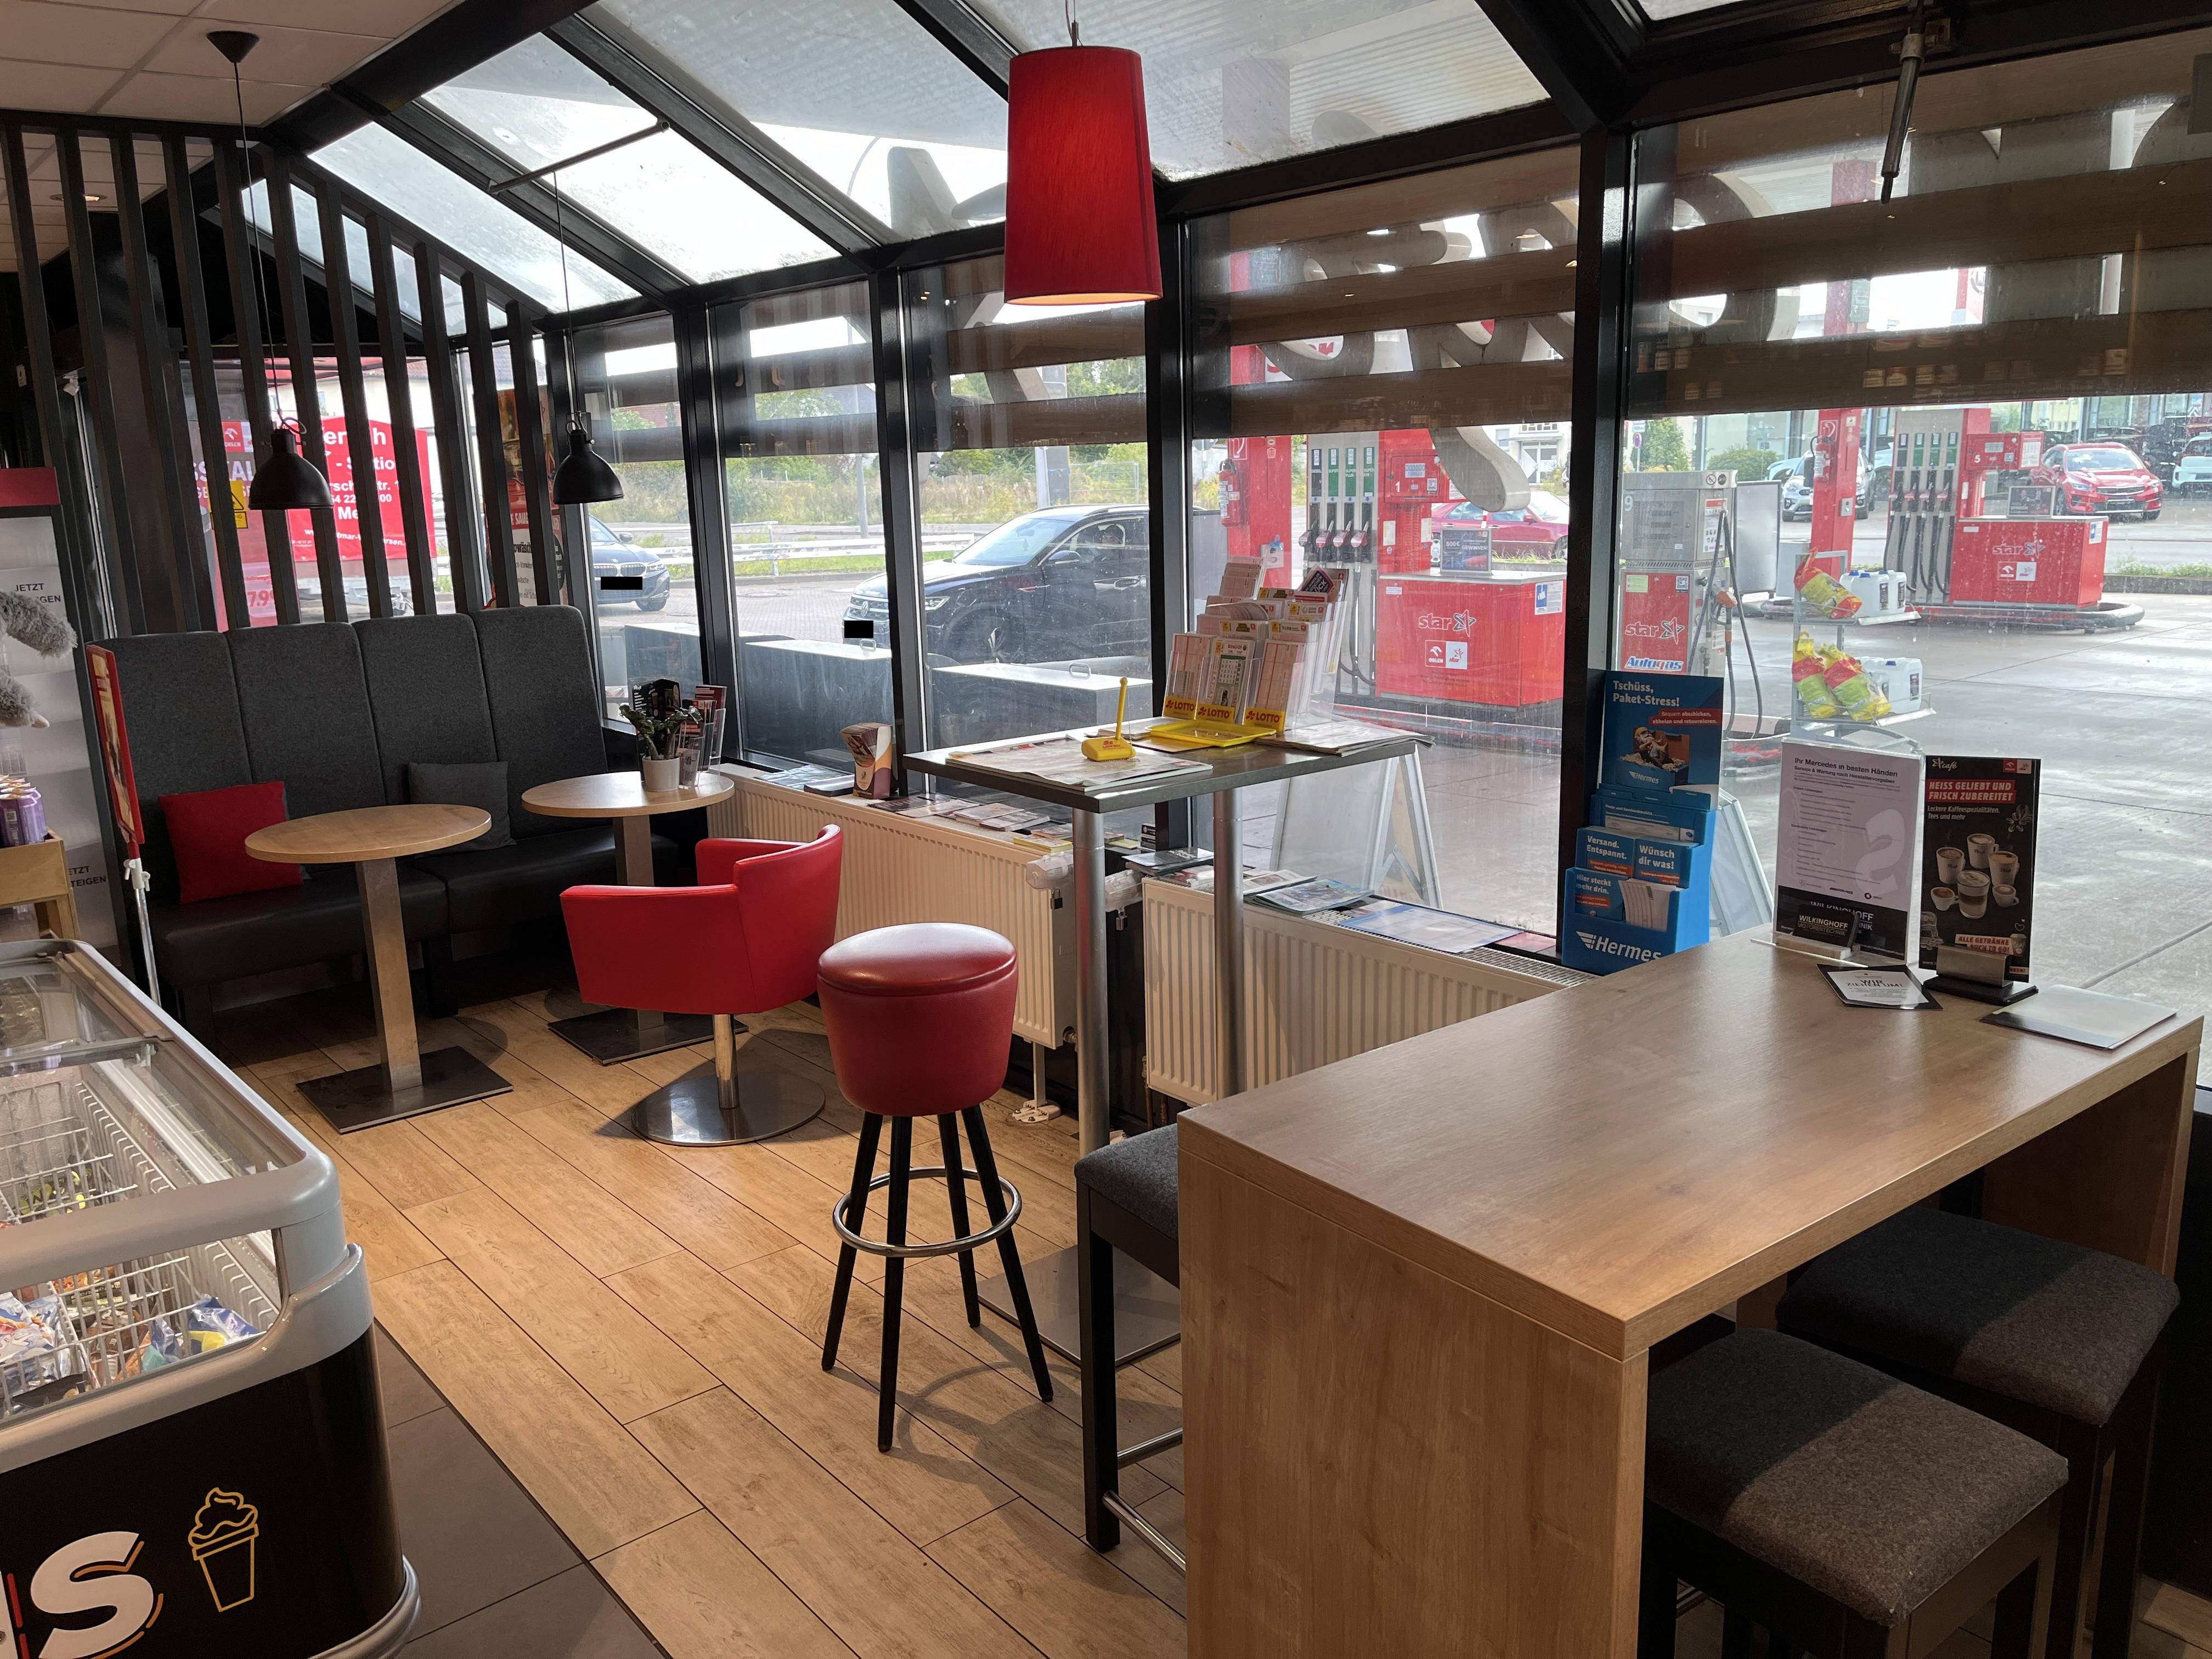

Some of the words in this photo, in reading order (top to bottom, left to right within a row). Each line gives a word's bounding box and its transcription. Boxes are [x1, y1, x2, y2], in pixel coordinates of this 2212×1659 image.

[1974, 455, 1981, 463] 5
[1395, 481, 1400, 493] 1
[1624, 495, 1633, 511] 9
[1992, 543, 2023, 555] star
[14, 583, 44, 592] JETZT
[1418, 612, 1452, 630] star
[1624, 621, 1659, 637] star
[1625, 657, 1684, 670] Autogas
[1613, 680, 1654, 693] Tschüss,
[1613, 693, 1680, 707] Paket-Stress!
[1174, 701, 1195, 712] LOTTO
[1207, 708, 1230, 719] LOTTO
[1256, 713, 1280, 723] LOTTO
[1805, 759, 1837, 769] Mercedes
[1846, 764, 1869, 774] besten
[1871, 768, 1898, 777] Händen
[1942, 761, 1958, 771] café
[1635, 772, 1660, 784] Hermes
[1929, 781, 1953, 790] HEISS
[1955, 782, 1991, 791] GELIEBT
[1992, 782, 2012, 791] UND
[1928, 791, 1958, 800] FRISCH
[1959, 792, 2013, 801] ZUBEREITET
[1587, 835, 1620, 849] Versand.
[1586, 844, 1627, 860] Entspannt.
[1639, 844, 1675, 859] Wünsch
[1638, 856, 1652, 865] dir
[1652, 859, 1674, 870] was!
[69, 866, 89, 876] ETZT
[71, 876, 106, 888] TEIGEN
[1576, 874, 1590, 883] Hier
[1590, 877, 1611, 887] steckt
[1576, 883, 1593, 891] mehr
[1593, 885, 1610, 894] drin.
[1799, 915, 1849, 929] WILKINGHOFF
[1974, 936, 2010, 945] GETRÄNKE
